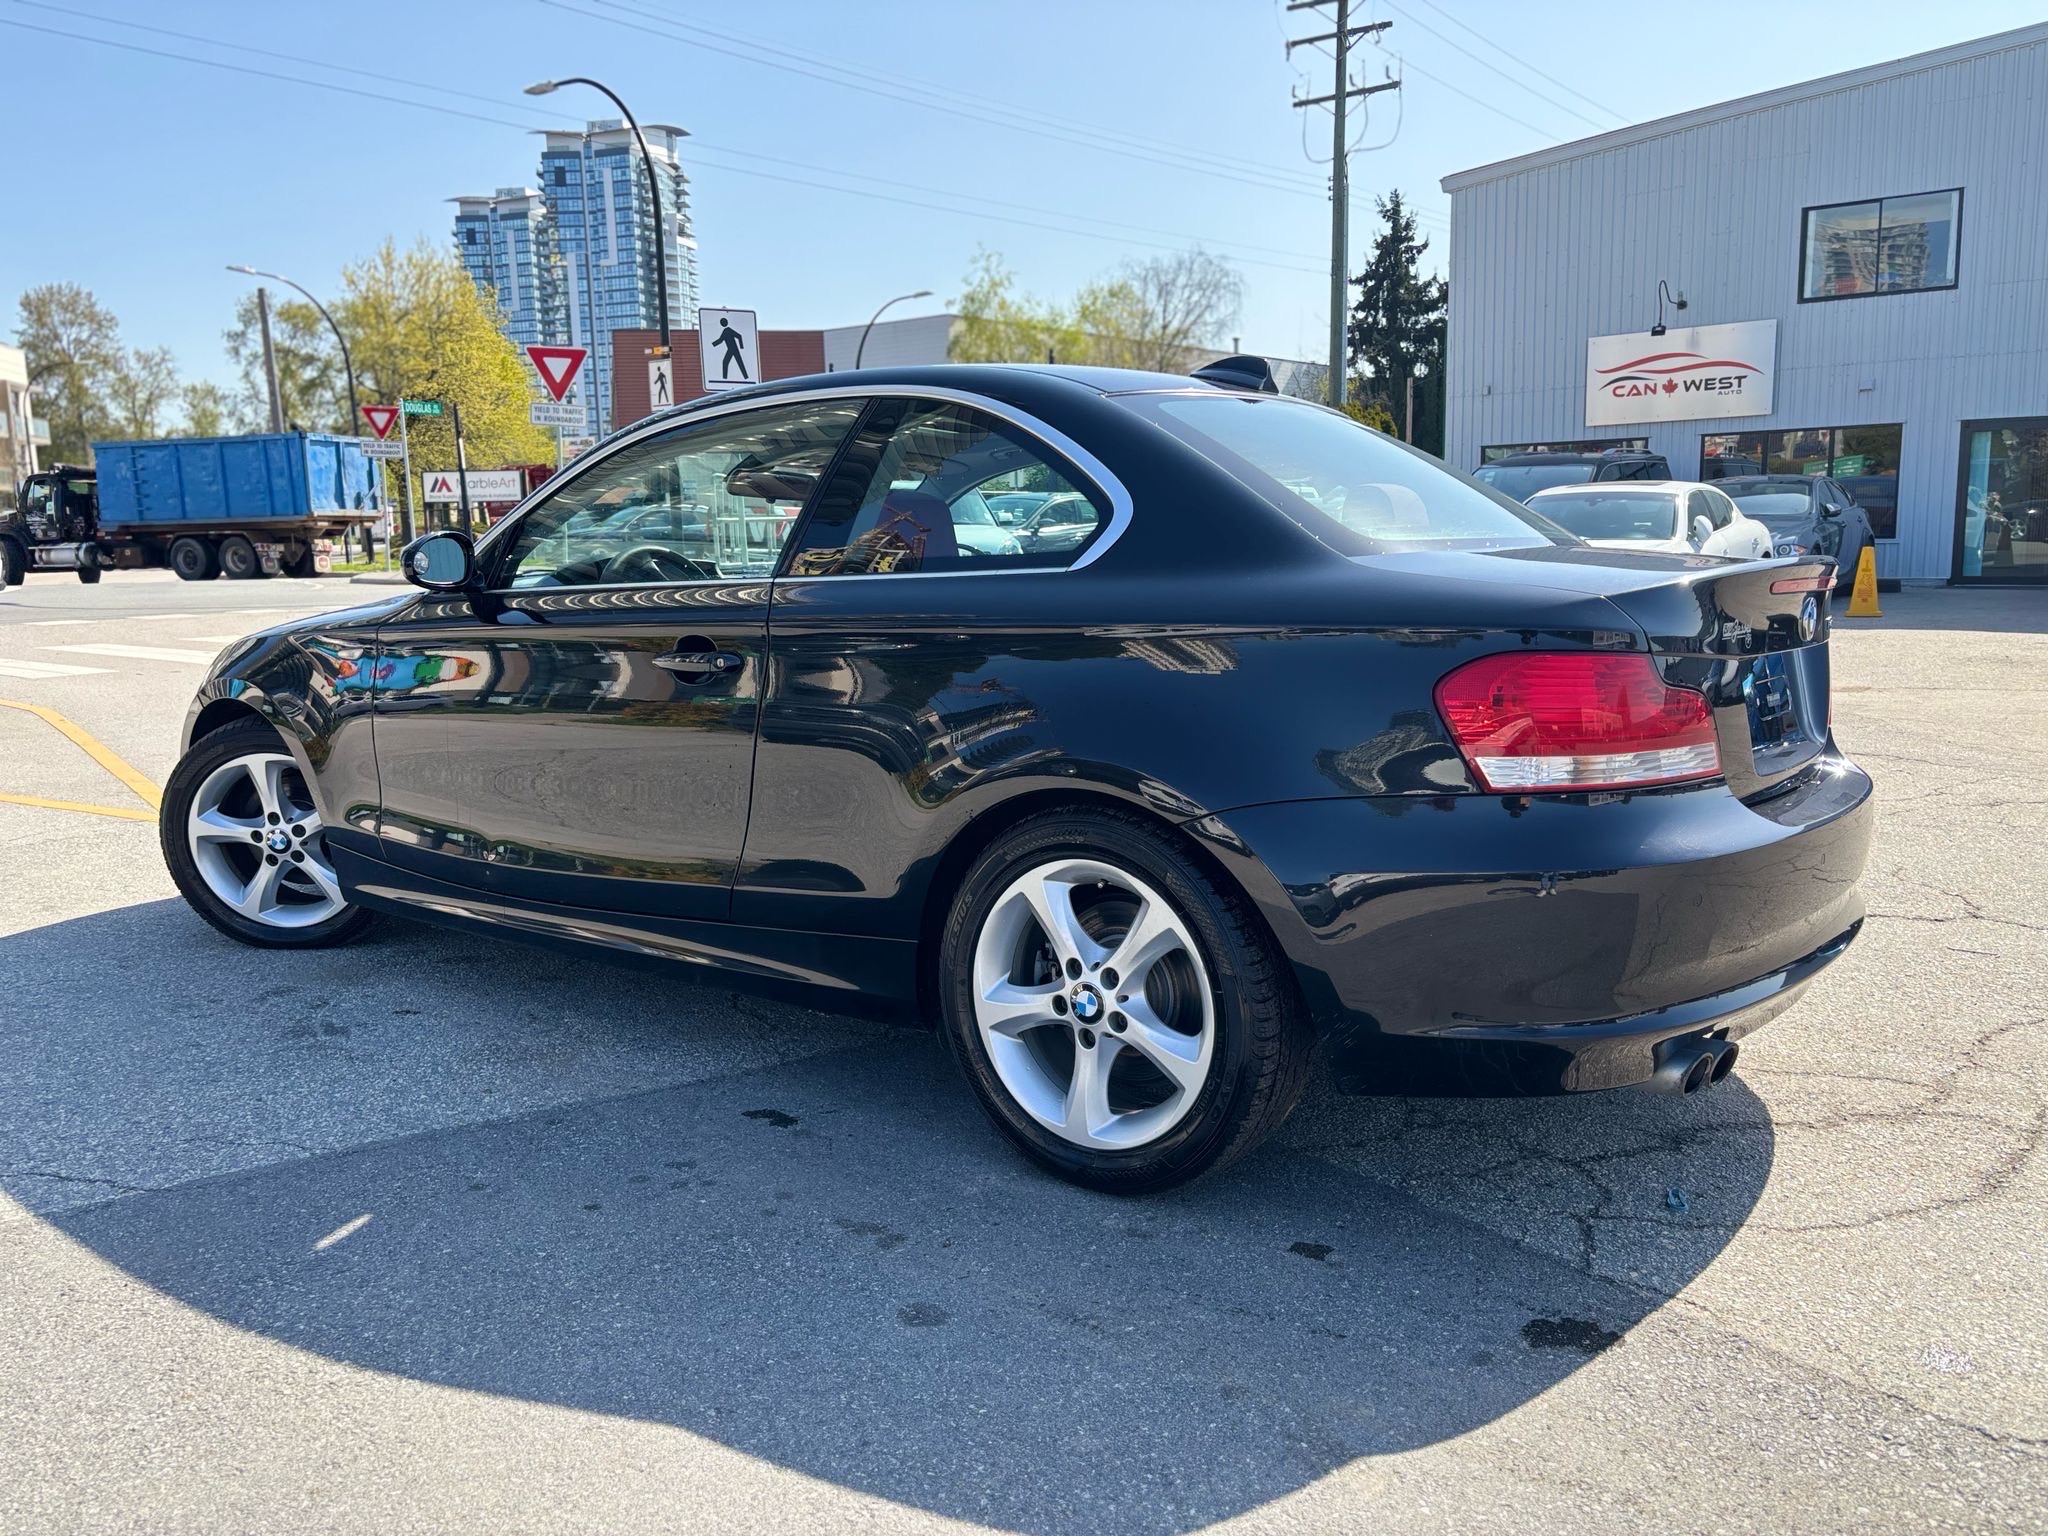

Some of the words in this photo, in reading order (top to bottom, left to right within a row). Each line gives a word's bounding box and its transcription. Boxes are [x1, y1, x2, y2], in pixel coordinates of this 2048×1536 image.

[1612, 383, 1657, 398] CAN
[1683, 375, 1748, 393] WEST
[405, 402, 431, 414] DOUGLAS
[534, 406, 550, 414] YIELD
[562, 407, 584, 416] TRAFFIC
[544, 415, 584, 425] ROUNDABOUT
[456, 477, 516, 489] arbleArt
